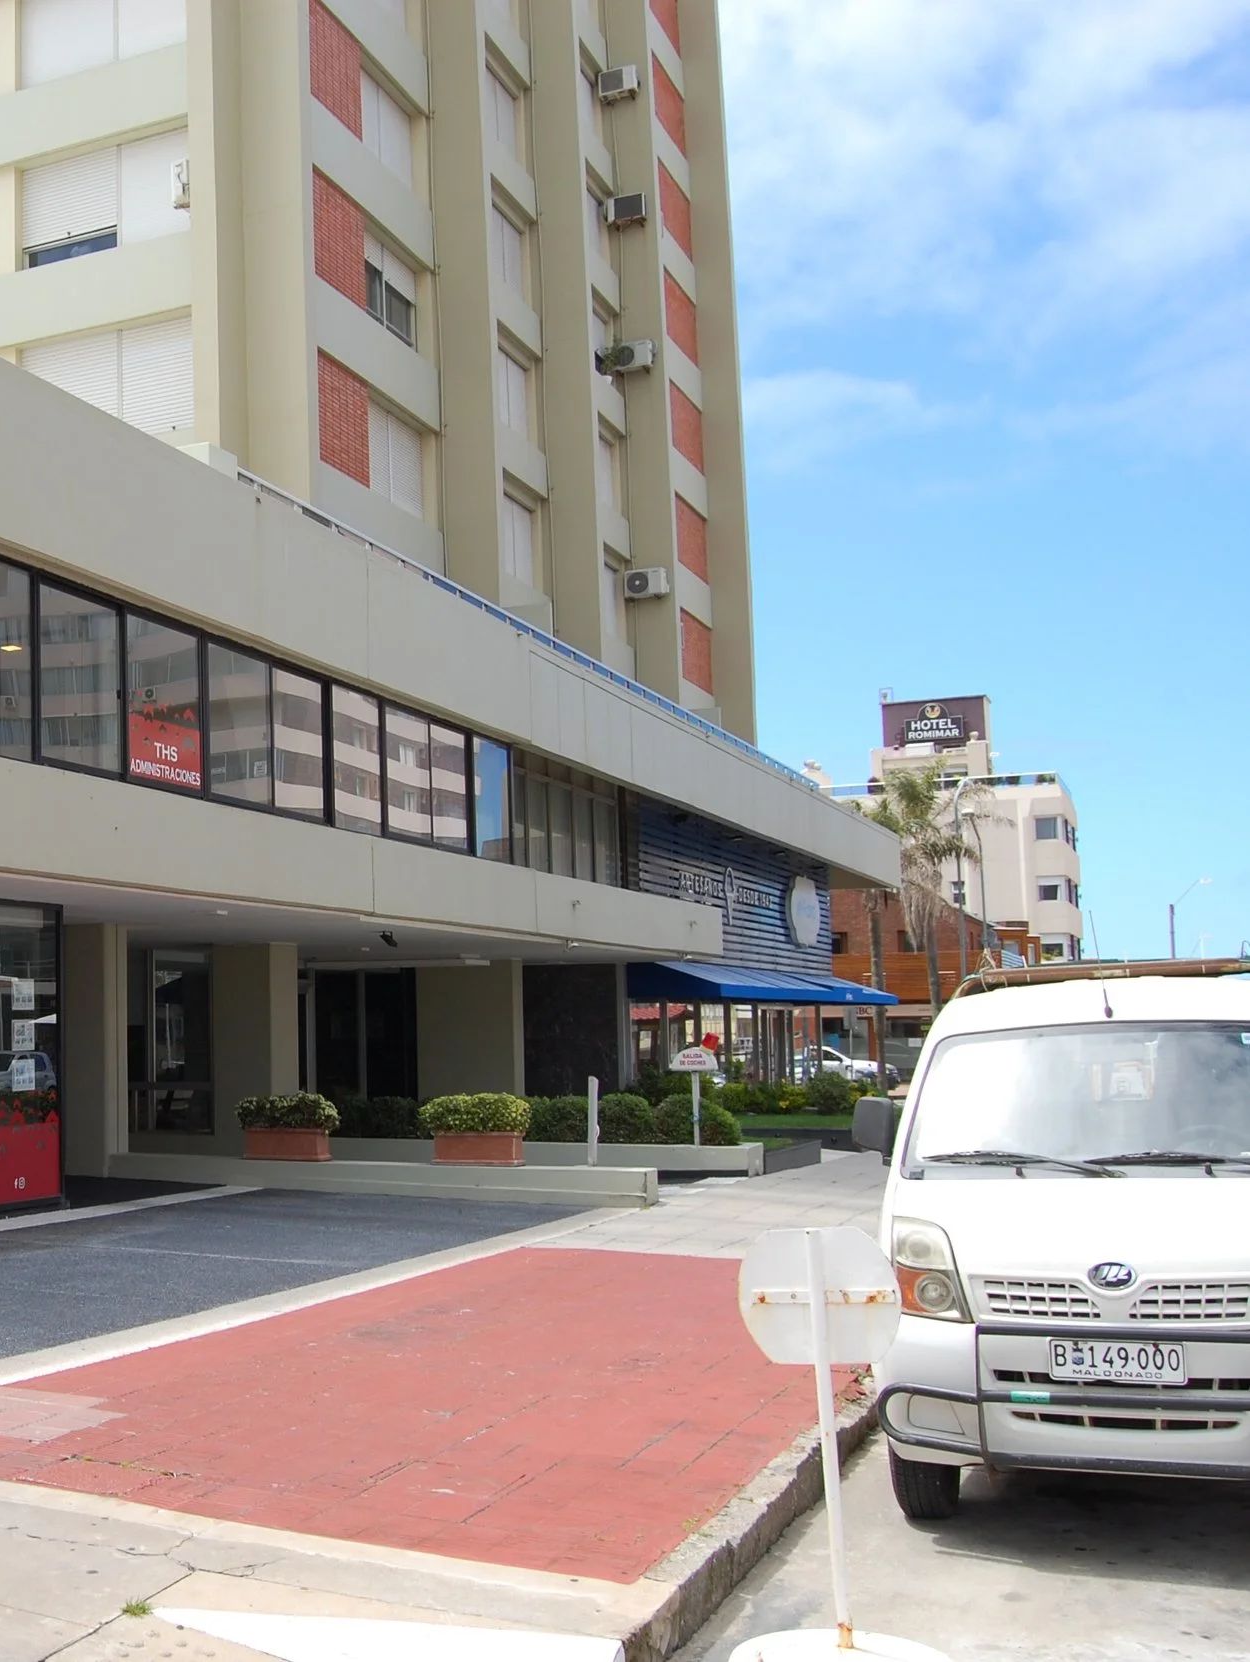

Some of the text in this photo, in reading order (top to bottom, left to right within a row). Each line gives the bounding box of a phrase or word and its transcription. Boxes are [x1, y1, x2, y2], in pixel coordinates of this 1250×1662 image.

[910, 719, 957, 731] HOTEL
[908, 729, 959, 739] ROMIMAR
[154, 742, 178, 762] THS
[130, 758, 201, 786] ADMINISTRACIONES
[1072, 1368, 1163, 1380] MALDONADO
